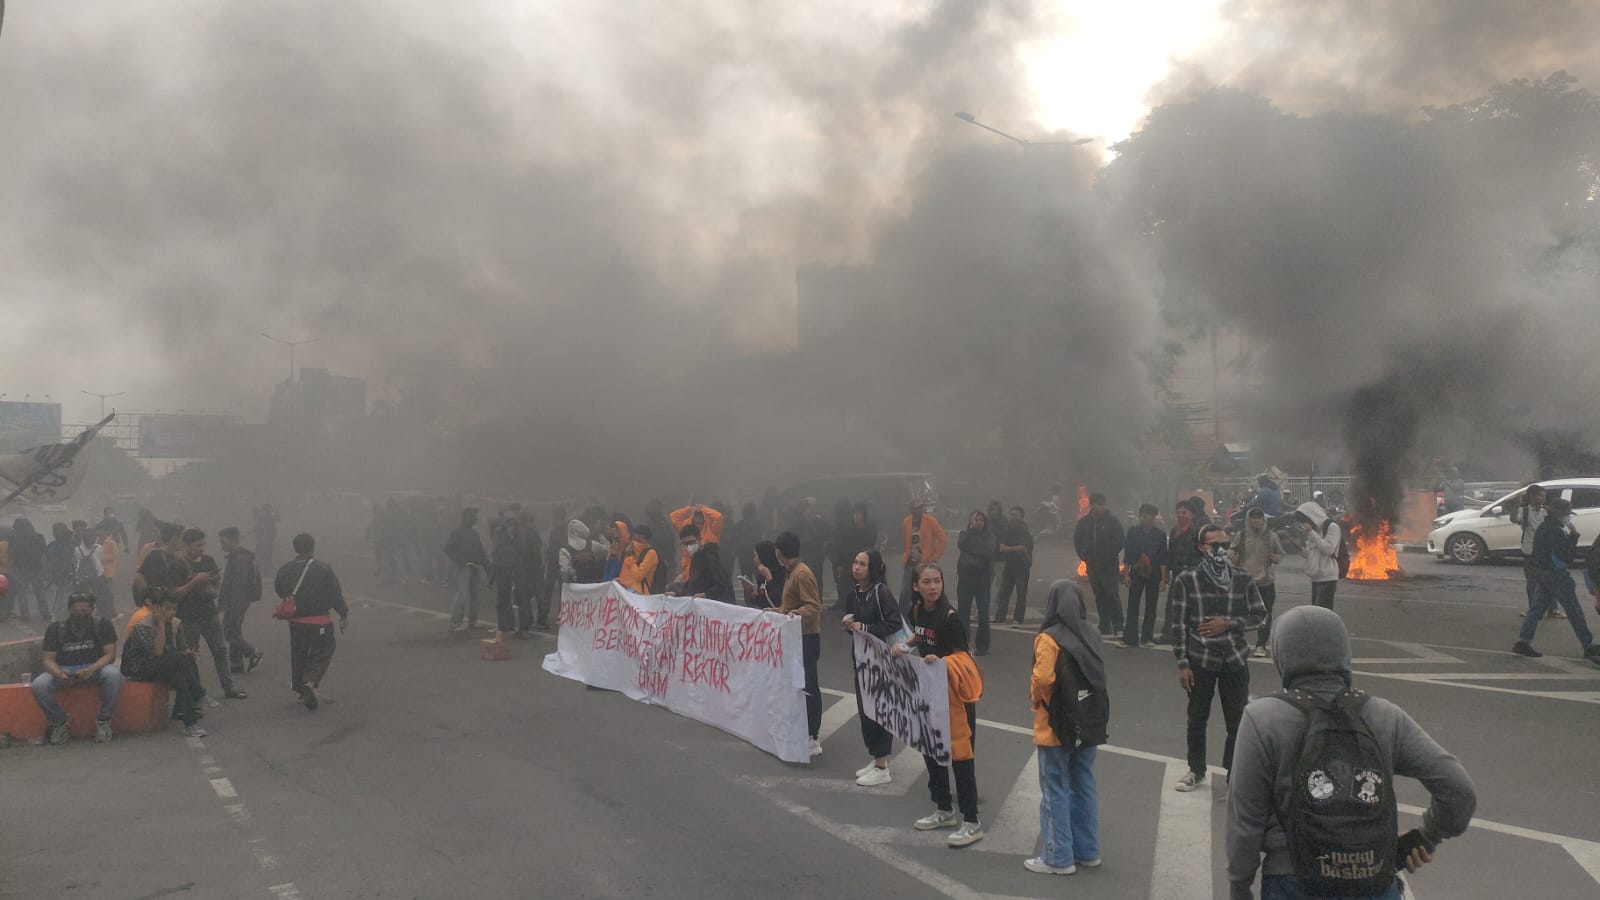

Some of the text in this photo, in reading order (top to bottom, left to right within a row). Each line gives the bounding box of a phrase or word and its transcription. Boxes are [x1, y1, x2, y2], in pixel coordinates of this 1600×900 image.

[699, 615, 735, 662] UNTUK
[738, 620, 783, 669] SEGERA
[680, 652, 731, 693] REKTOR
